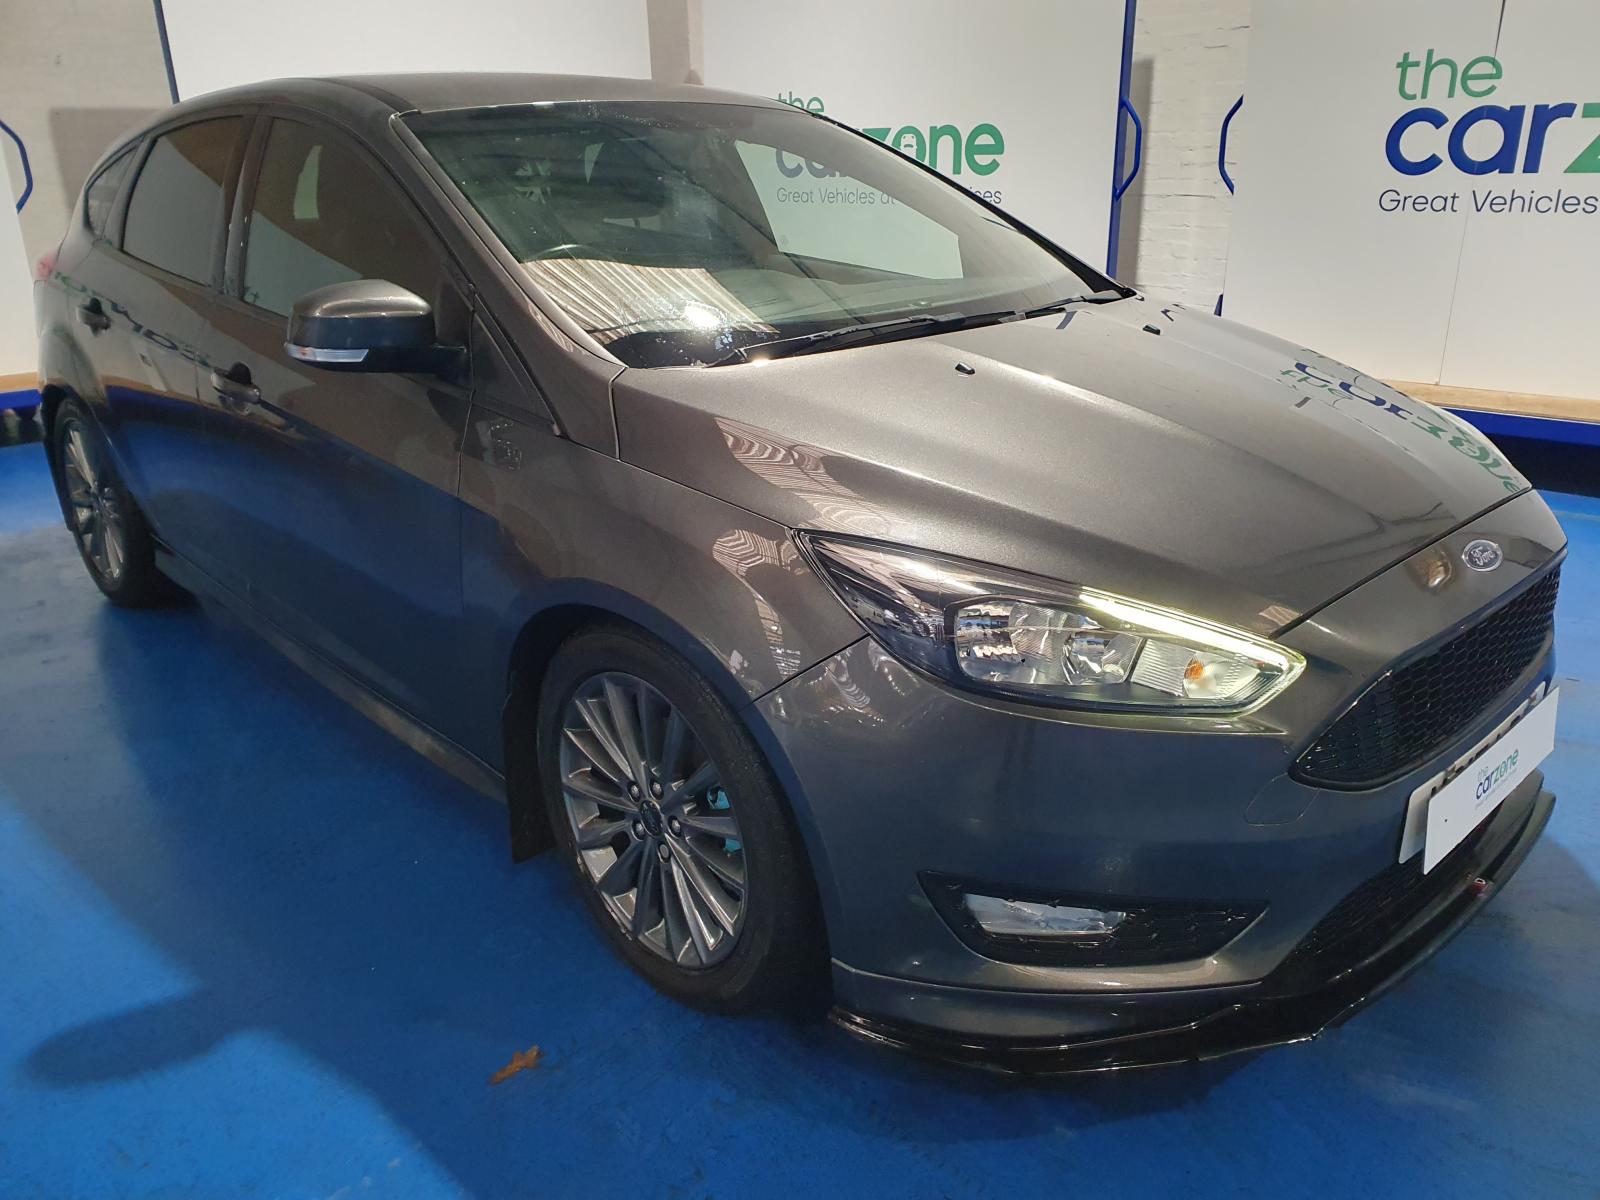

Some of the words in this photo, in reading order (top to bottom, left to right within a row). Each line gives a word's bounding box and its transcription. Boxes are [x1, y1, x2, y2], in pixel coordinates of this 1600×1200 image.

[1396, 48, 1503, 100] the
[776, 186, 815, 204] Great
[819, 187, 876, 205] Vehicles
[1378, 188, 1460, 213] Great
[1472, 188, 1599, 214] Vehicles
[1475, 749, 1519, 800] carzone
